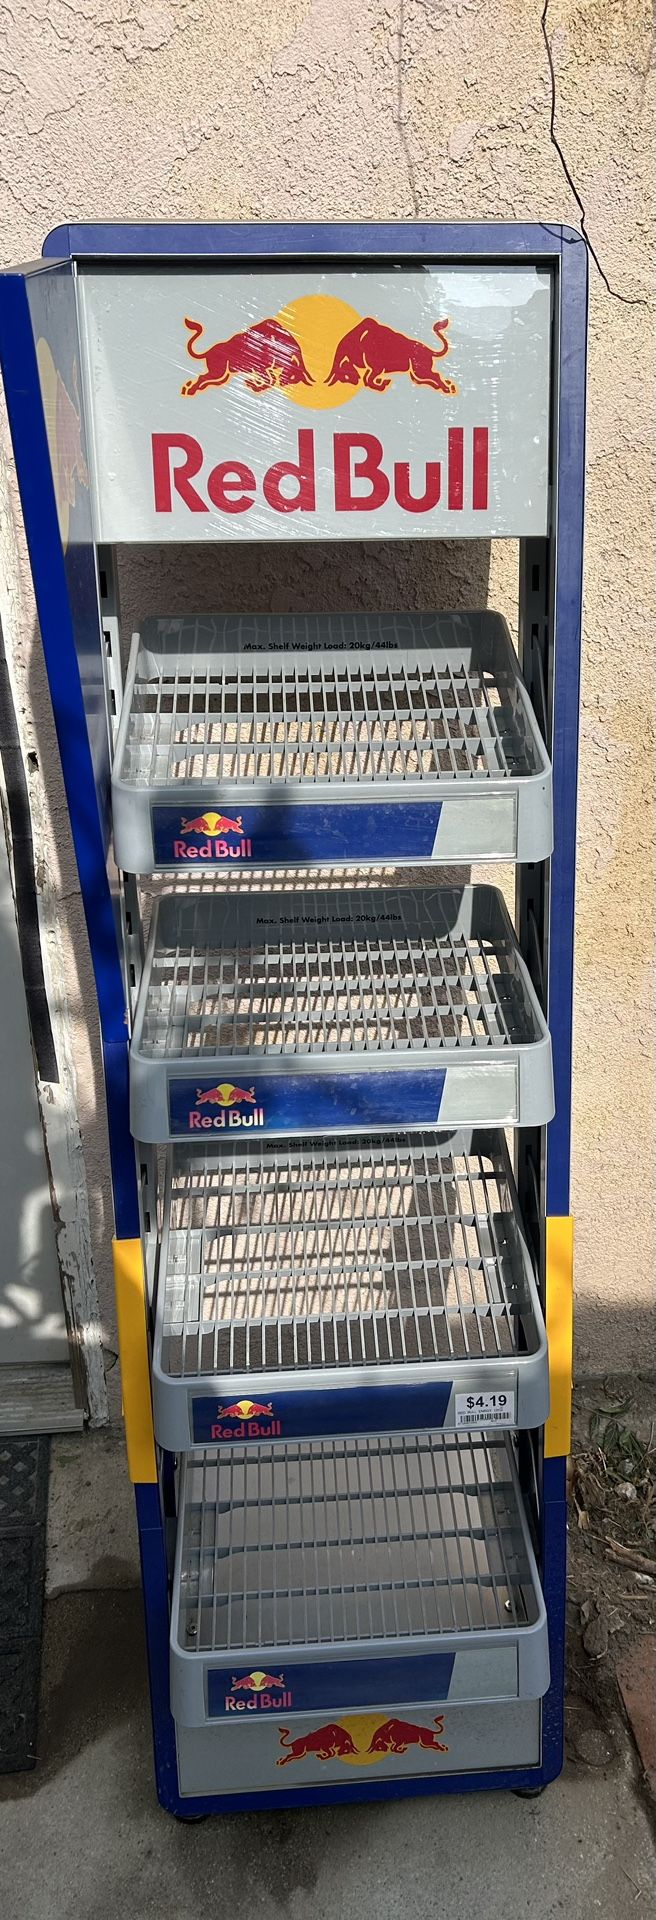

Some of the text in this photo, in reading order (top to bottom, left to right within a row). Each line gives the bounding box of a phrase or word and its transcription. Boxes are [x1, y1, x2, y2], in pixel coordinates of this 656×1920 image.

[151, 427, 489, 513] Red Bull
[268, 642, 289, 650] Shelf
[291, 642, 322, 651] Weight
[324, 642, 347, 650] Load:
[349, 641, 398, 650] 20kg/44lbs
[173, 839, 252, 858] Red Bull
[256, 917, 277, 925] Max.
[301, 916, 330, 924] Weight
[331, 915, 354, 923] Load:
[355, 914, 402, 923] 20kg/44lbs
[188, 1108, 264, 1129] Red Bull
[309, 1140, 337, 1148] Weight
[466, 1395, 507, 1409] $4.19
[211, 1420, 281, 1439] Red Bull
[224, 1691, 292, 1711] Red Bull
